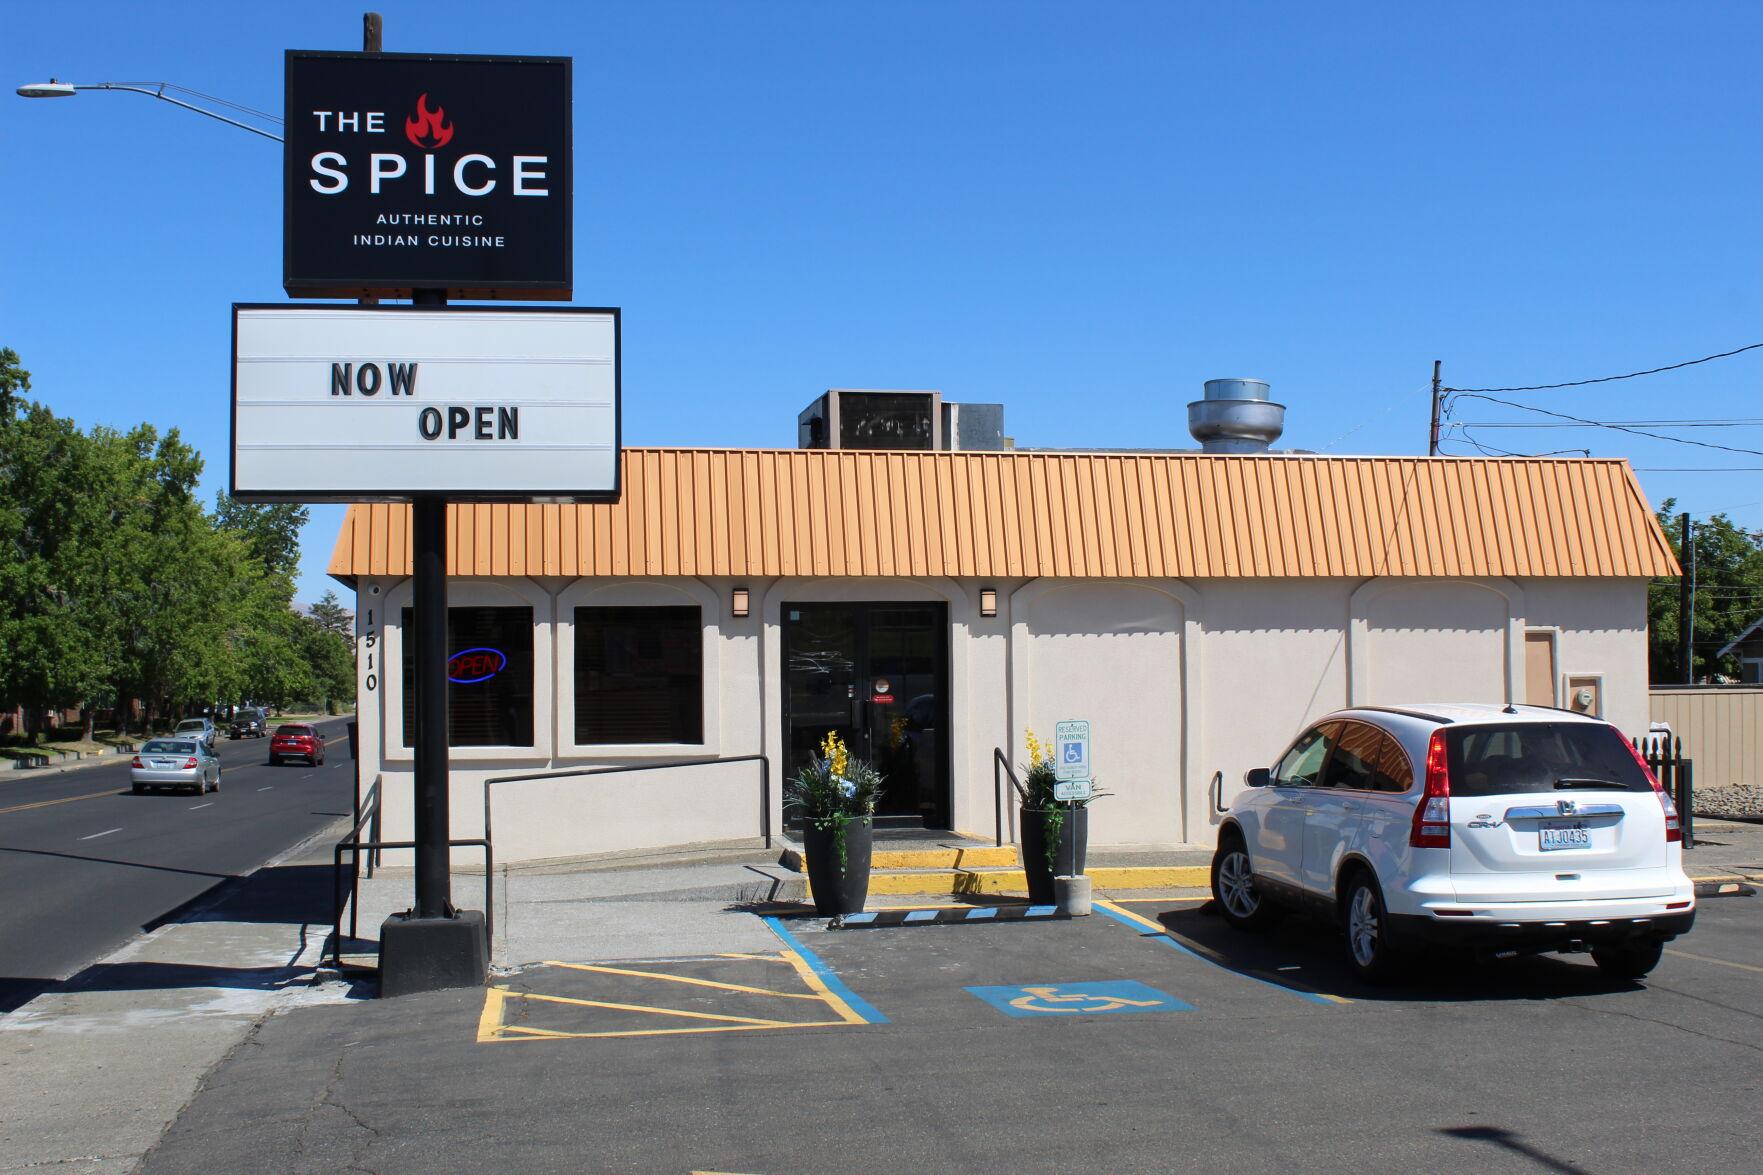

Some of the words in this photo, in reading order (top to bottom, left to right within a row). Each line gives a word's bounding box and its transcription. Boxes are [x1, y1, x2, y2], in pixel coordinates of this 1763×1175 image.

[313, 111, 386, 133] THE
[309, 151, 549, 197] SPICE
[376, 213, 484, 226] AUTHENTIC
[353, 234, 419, 246] INDIAN
[428, 235, 505, 247] CUISINE
[331, 362, 418, 396] NOW
[418, 406, 519, 440] OPEN
[366, 609, 377, 691] 1510
[448, 655, 499, 678] OPEN
[1058, 725, 1088, 733] RESERVED
[1059, 733, 1086, 741] PARKING
